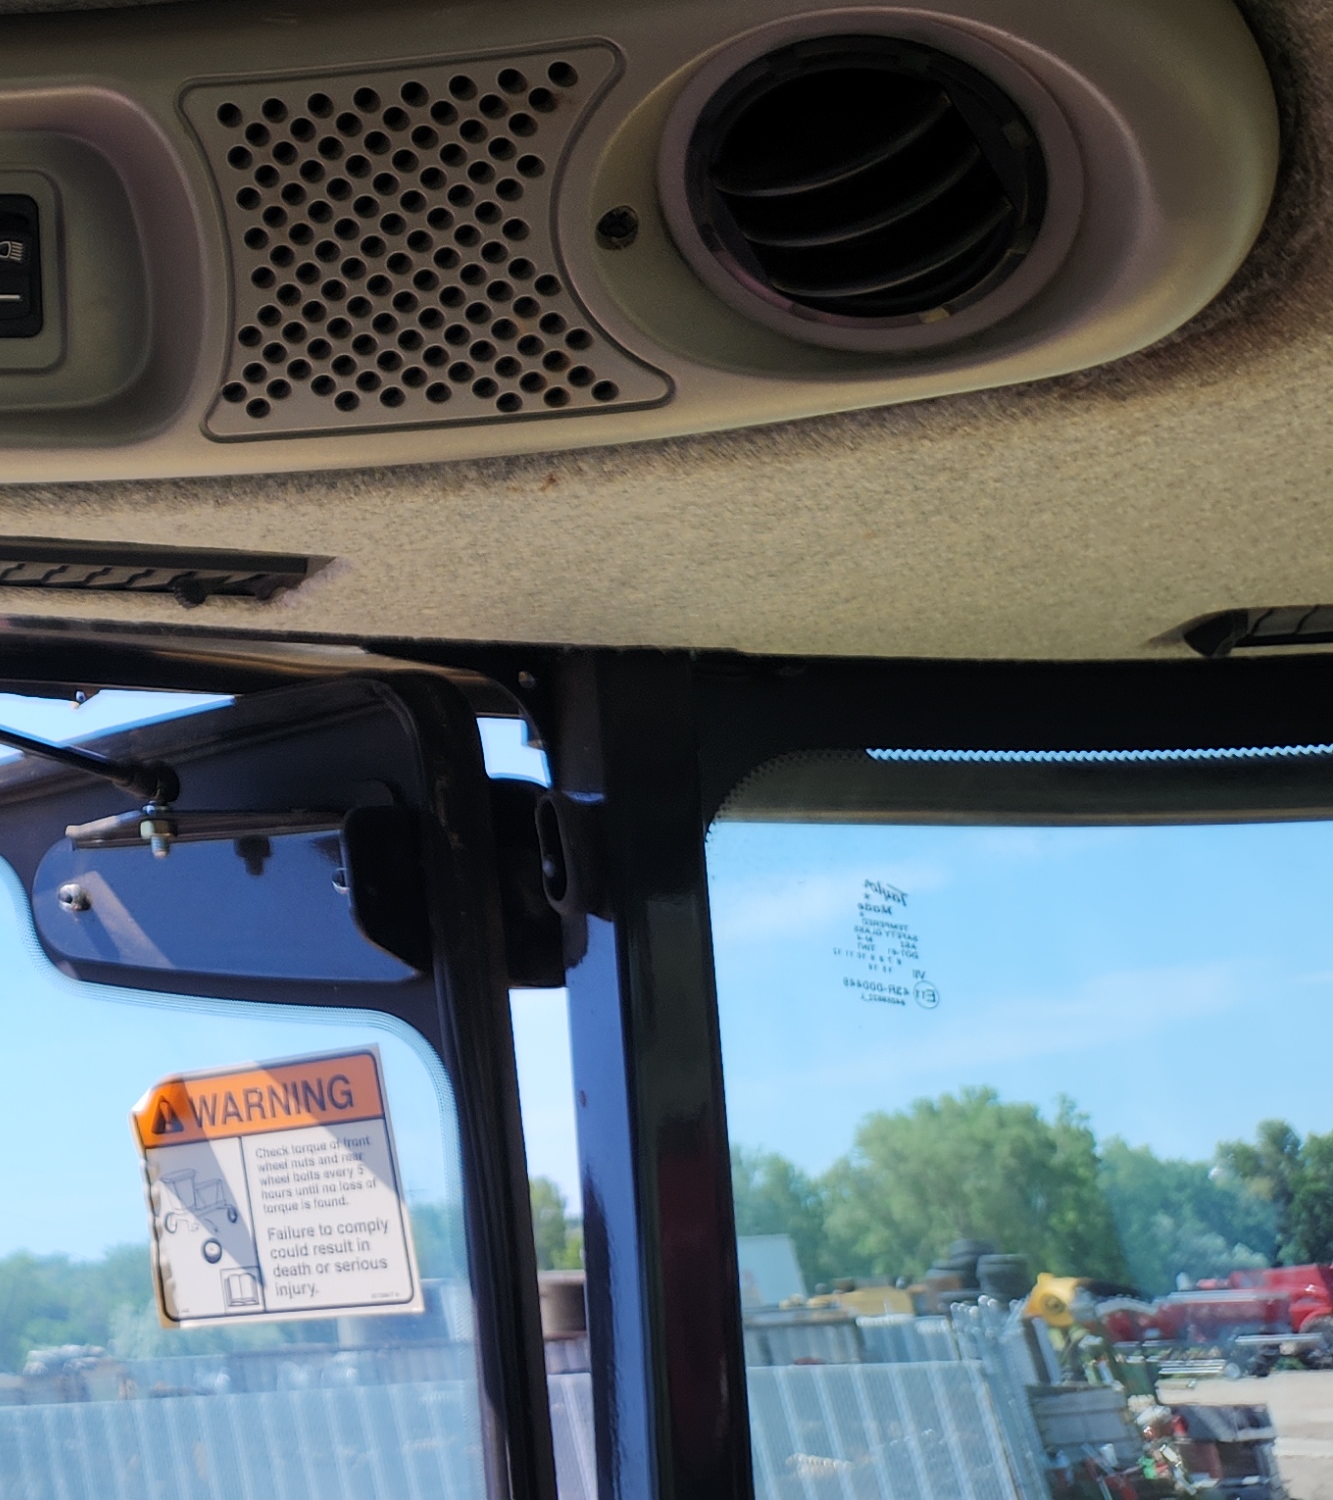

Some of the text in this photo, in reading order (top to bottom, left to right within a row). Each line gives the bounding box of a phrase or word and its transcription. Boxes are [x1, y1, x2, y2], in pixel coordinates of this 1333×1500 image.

[188, 1073, 355, 1129] WARNING
[255, 1135, 371, 1159] Check torque of front
[257, 1151, 364, 1172] wheel nuts and rear
[259, 1172, 290, 1186] wheel
[293, 1168, 321, 1183] bolts
[323, 1165, 354, 1180] every
[261, 1176, 377, 1200] hours until no loss of
[262, 1193, 350, 1216] torque is found.
[267, 1216, 389, 1242] Failure to comply
[270, 1236, 371, 1260] could result in
[272, 1255, 389, 1278] death or serious
[274, 1280, 320, 1299] injury.
